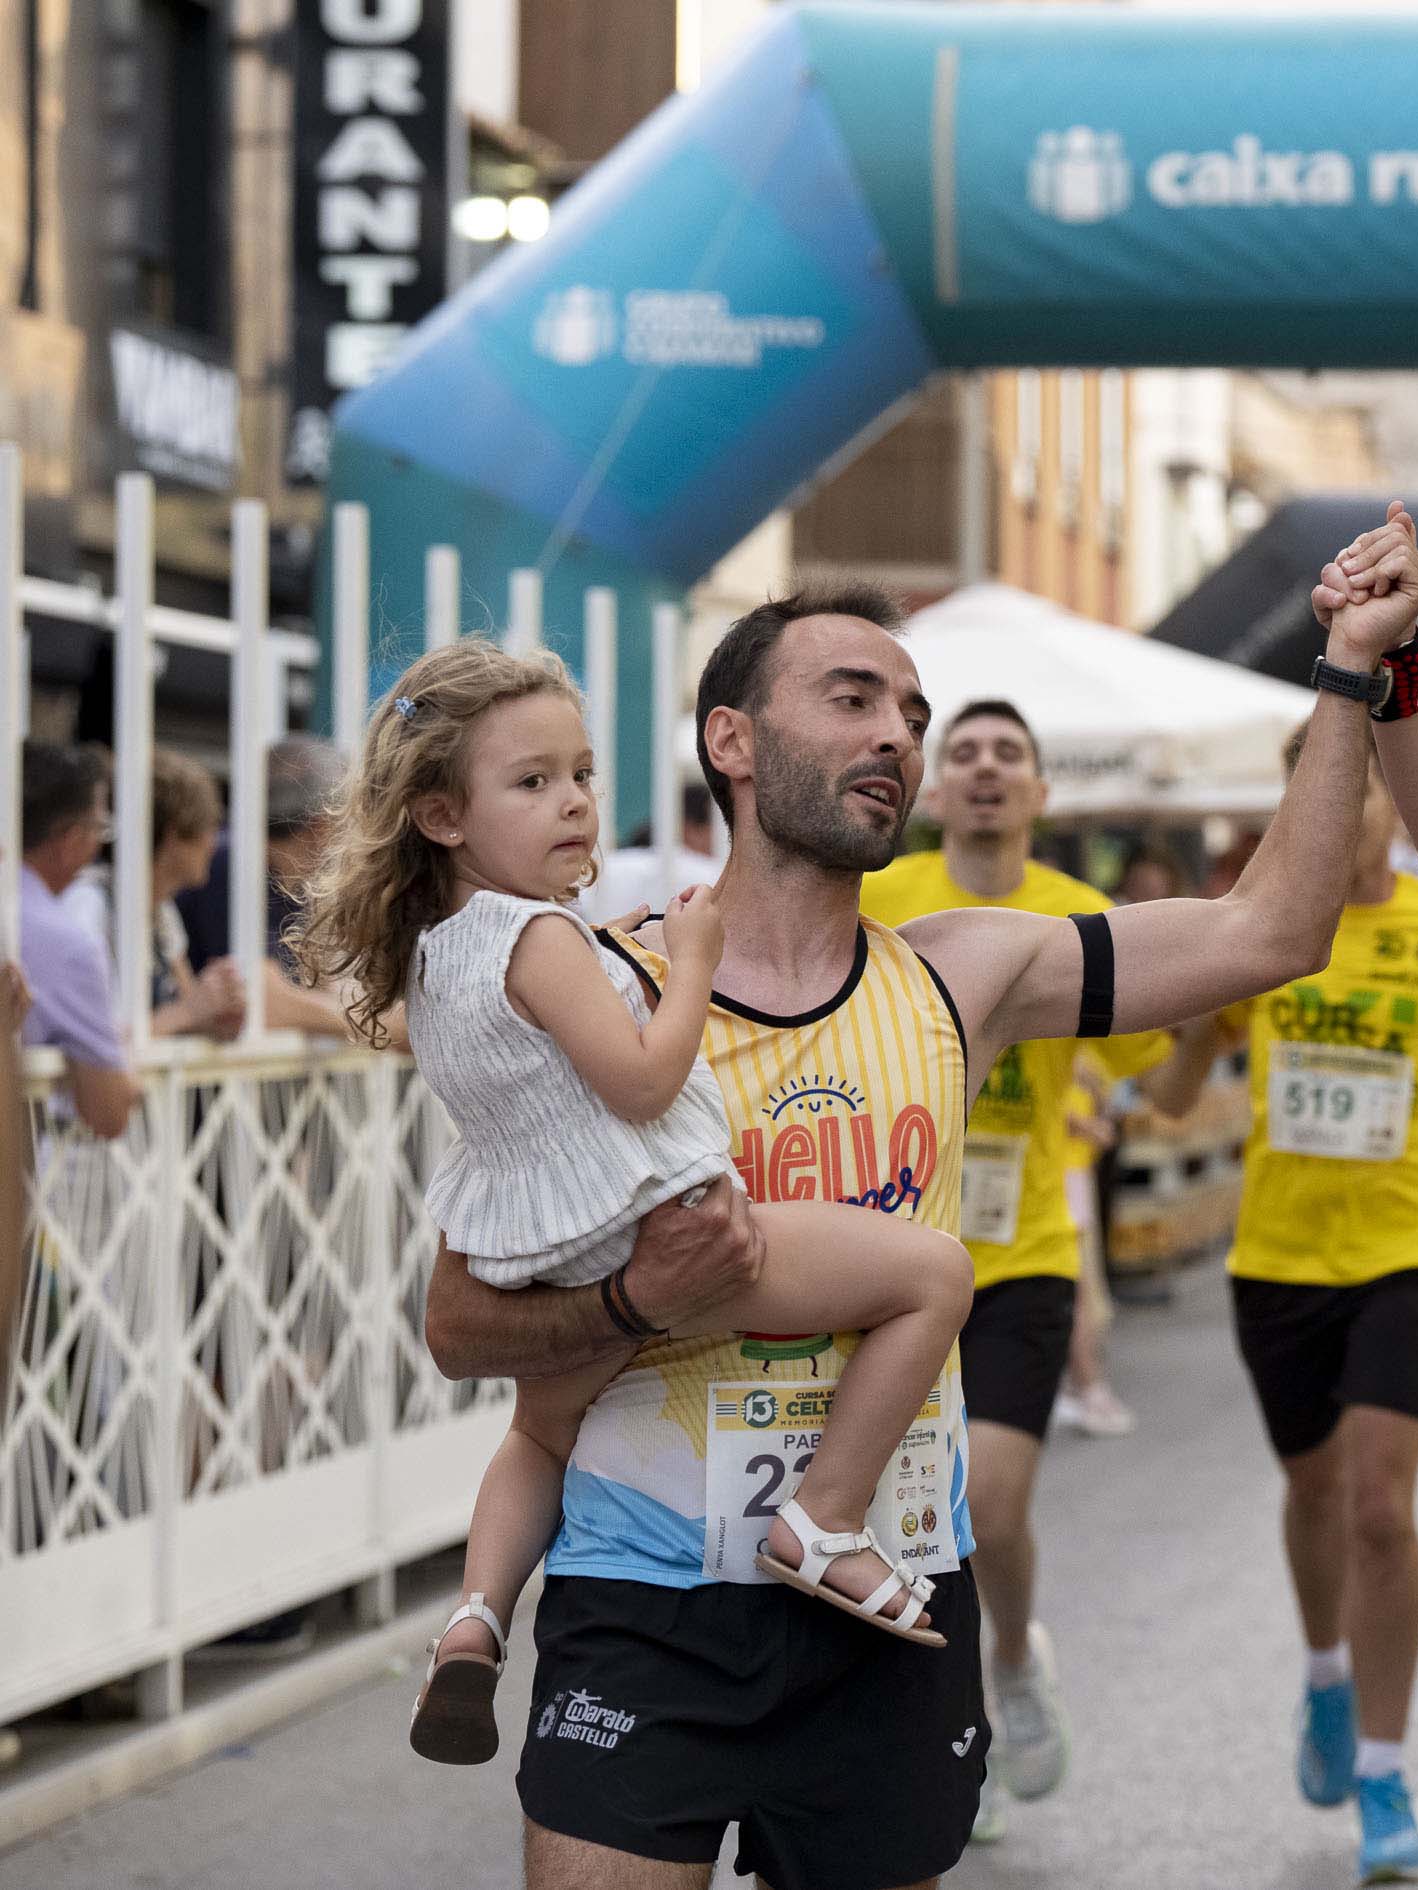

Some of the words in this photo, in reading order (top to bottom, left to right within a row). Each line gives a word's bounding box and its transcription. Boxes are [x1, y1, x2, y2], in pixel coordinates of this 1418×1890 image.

[1148, 132, 1355, 206] caixa
[1283, 1081, 1355, 1122] 519
[795, 1391, 825, 1400] CURSA
[786, 1400, 834, 1417] CELT
[784, 1433, 822, 1450] PAB
[557, 1721, 618, 1749] CASTELLÓ
